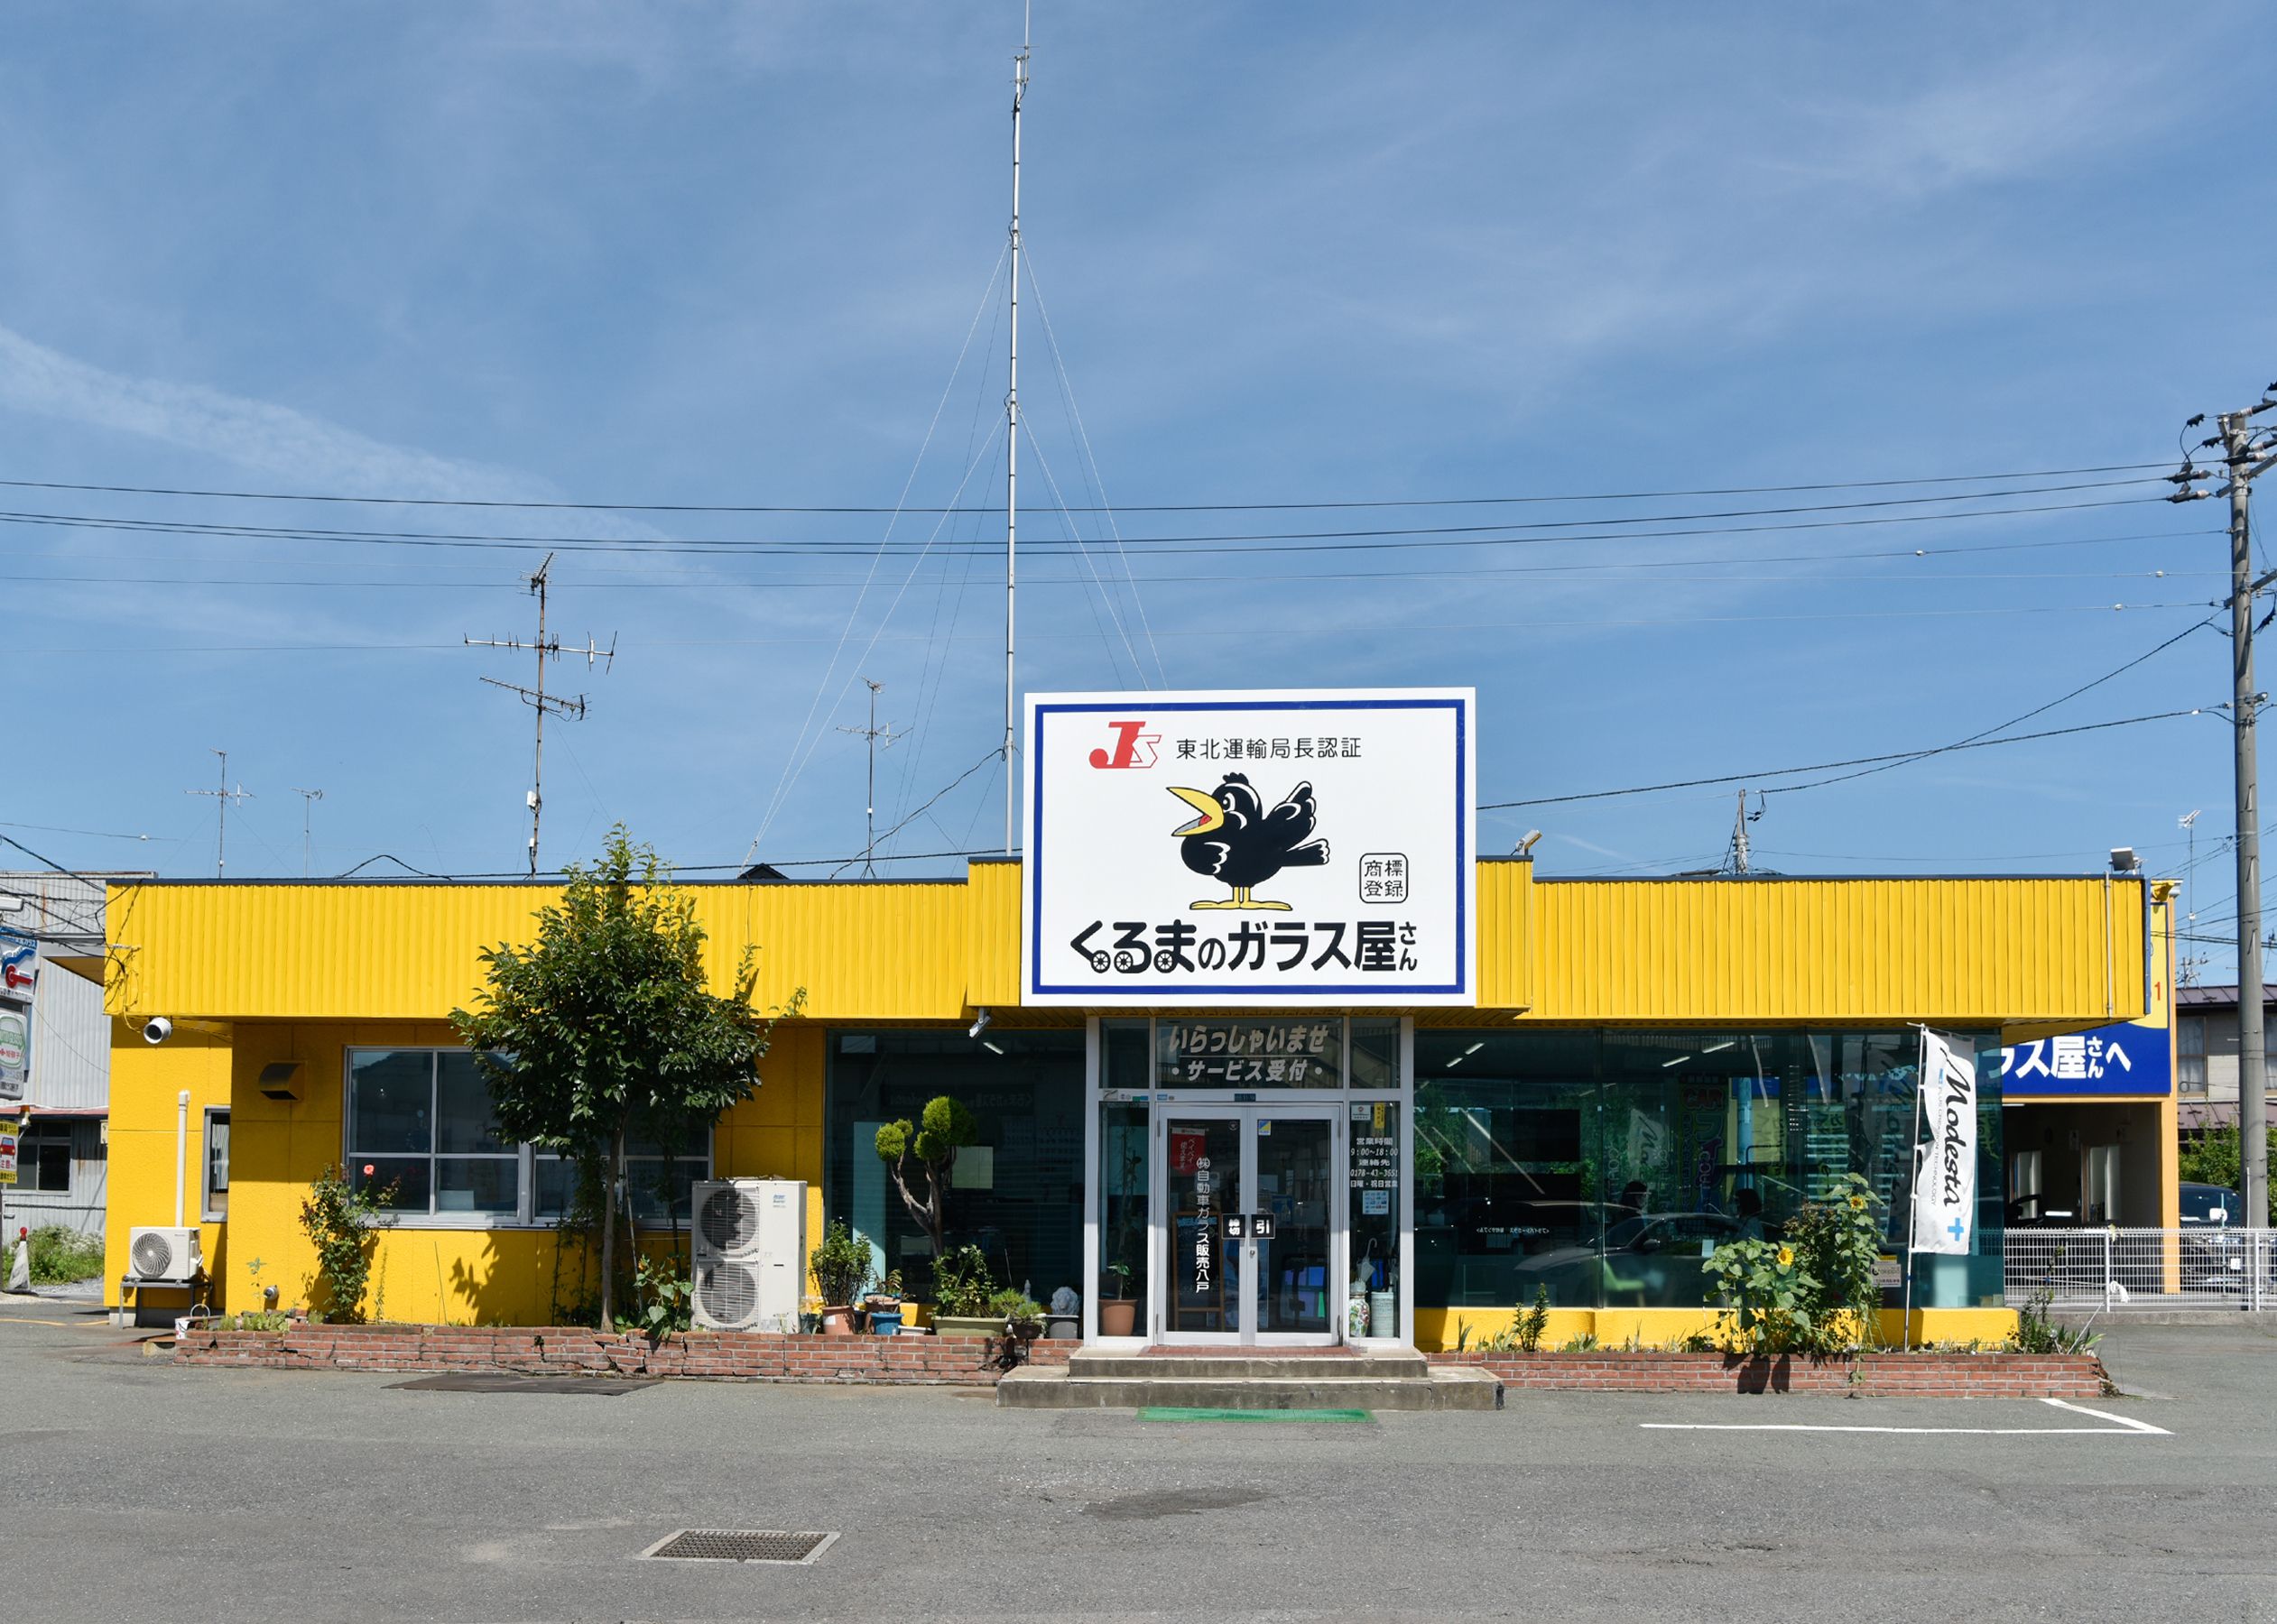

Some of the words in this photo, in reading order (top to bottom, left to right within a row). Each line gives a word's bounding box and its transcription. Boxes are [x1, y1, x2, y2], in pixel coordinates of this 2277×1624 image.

[1175, 736, 1362, 760] 東北運輸局長認証
[1363, 859, 1404, 879] 商標
[1363, 879, 1404, 899] 登録
[1169, 1024, 1329, 1054] いらっしゃいませ
[1939, 1047, 1971, 1207] Modesta
[1356, 1137, 1393, 1146] 営業時間
[1349, 1168, 1398, 1176] 0178-43-3551
[1358, 1158, 1391, 1167] 連絡先
[1255, 1219, 1270, 1234] 引
